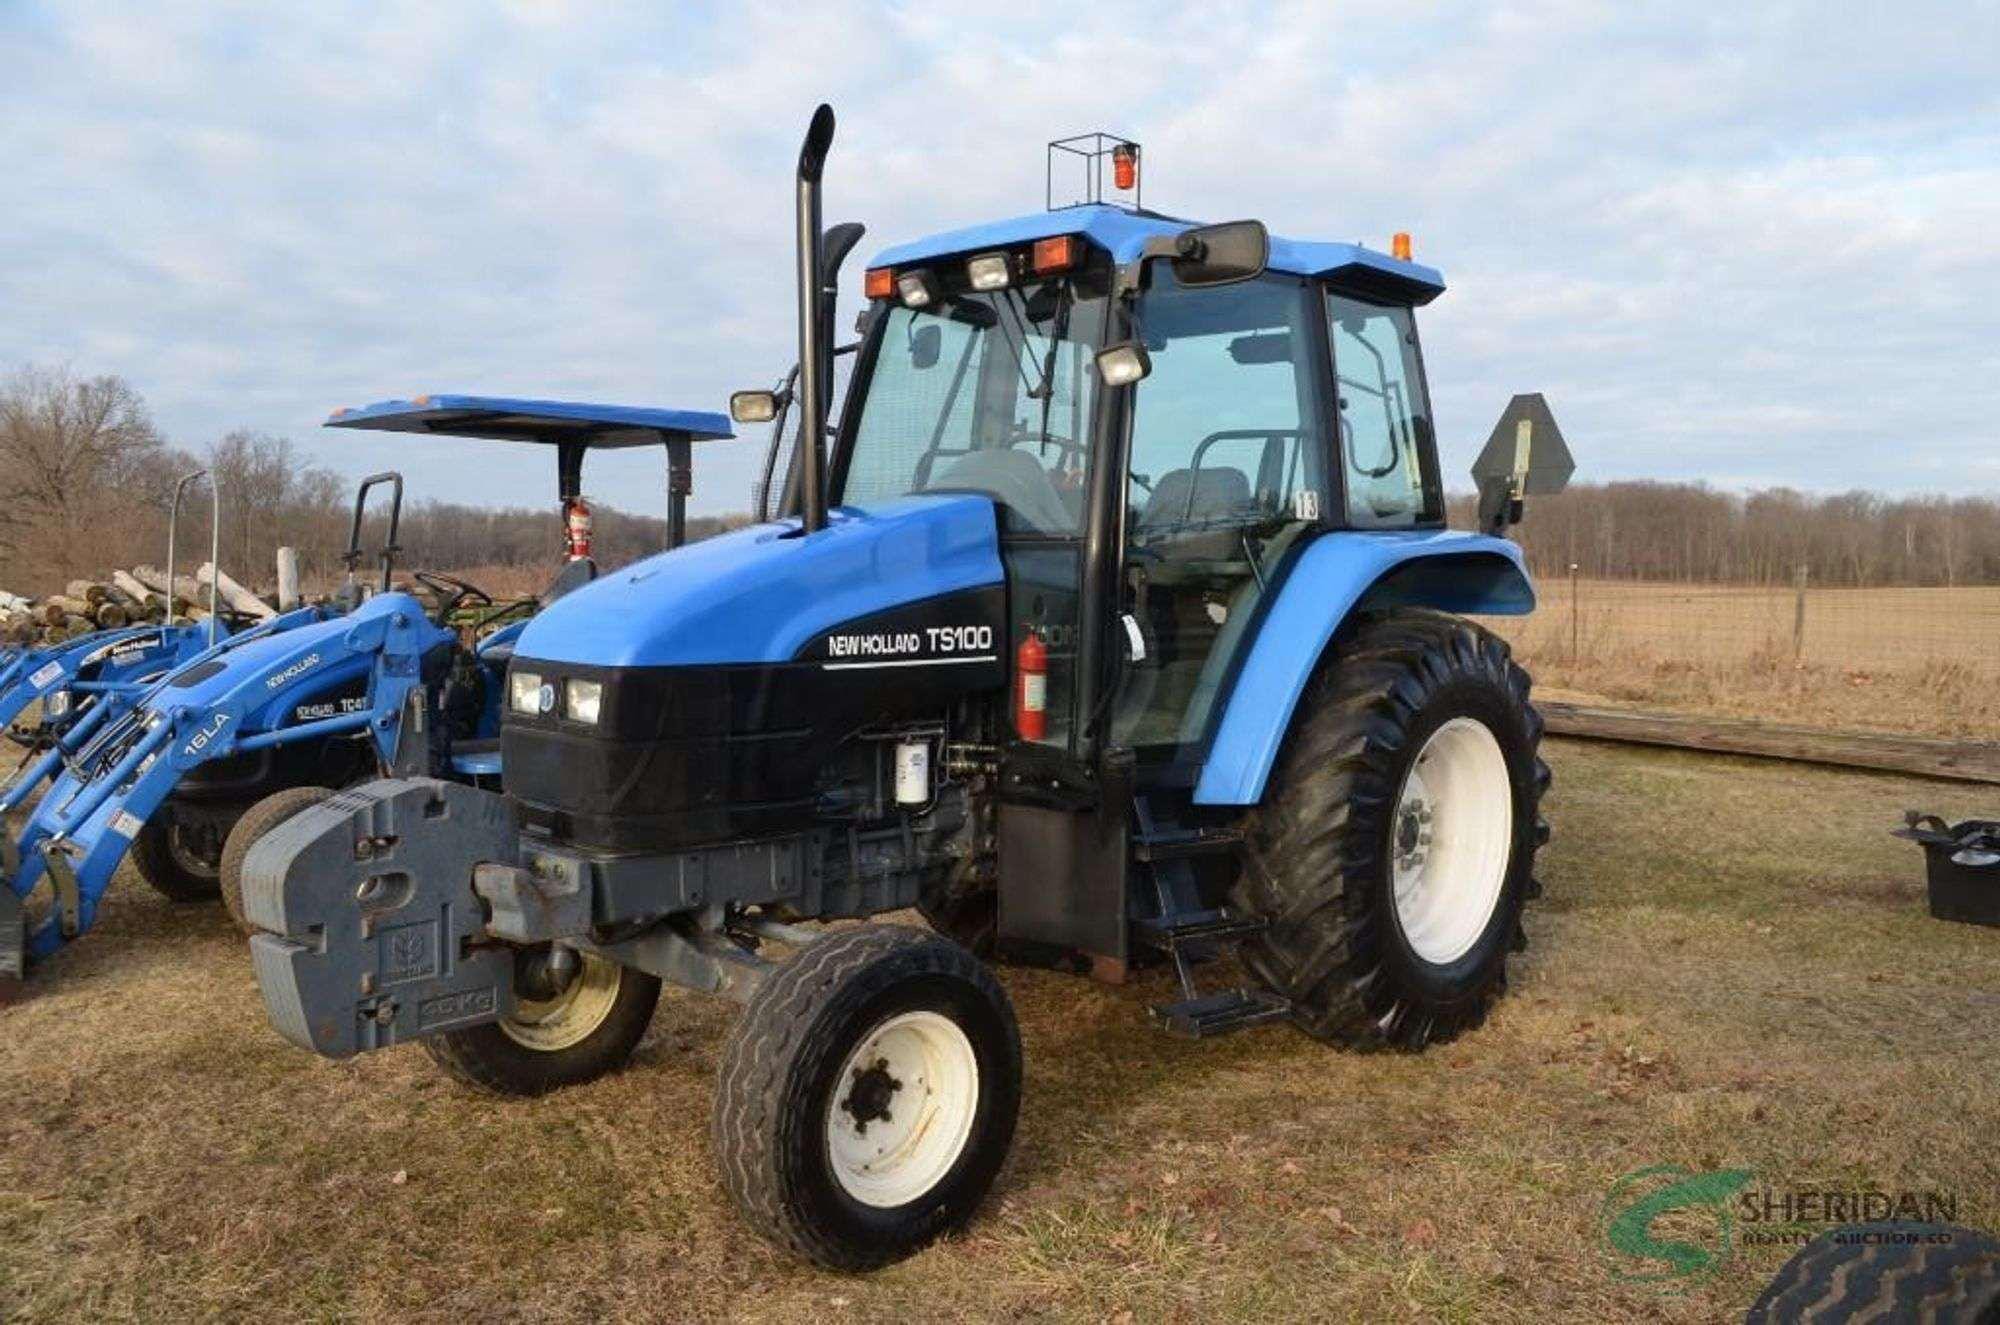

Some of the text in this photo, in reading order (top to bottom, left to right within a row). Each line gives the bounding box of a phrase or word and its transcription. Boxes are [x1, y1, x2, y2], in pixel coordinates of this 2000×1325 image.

[828, 627, 992, 656] NEW HOLLAND TS100
[184, 712, 230, 755] 16LA
